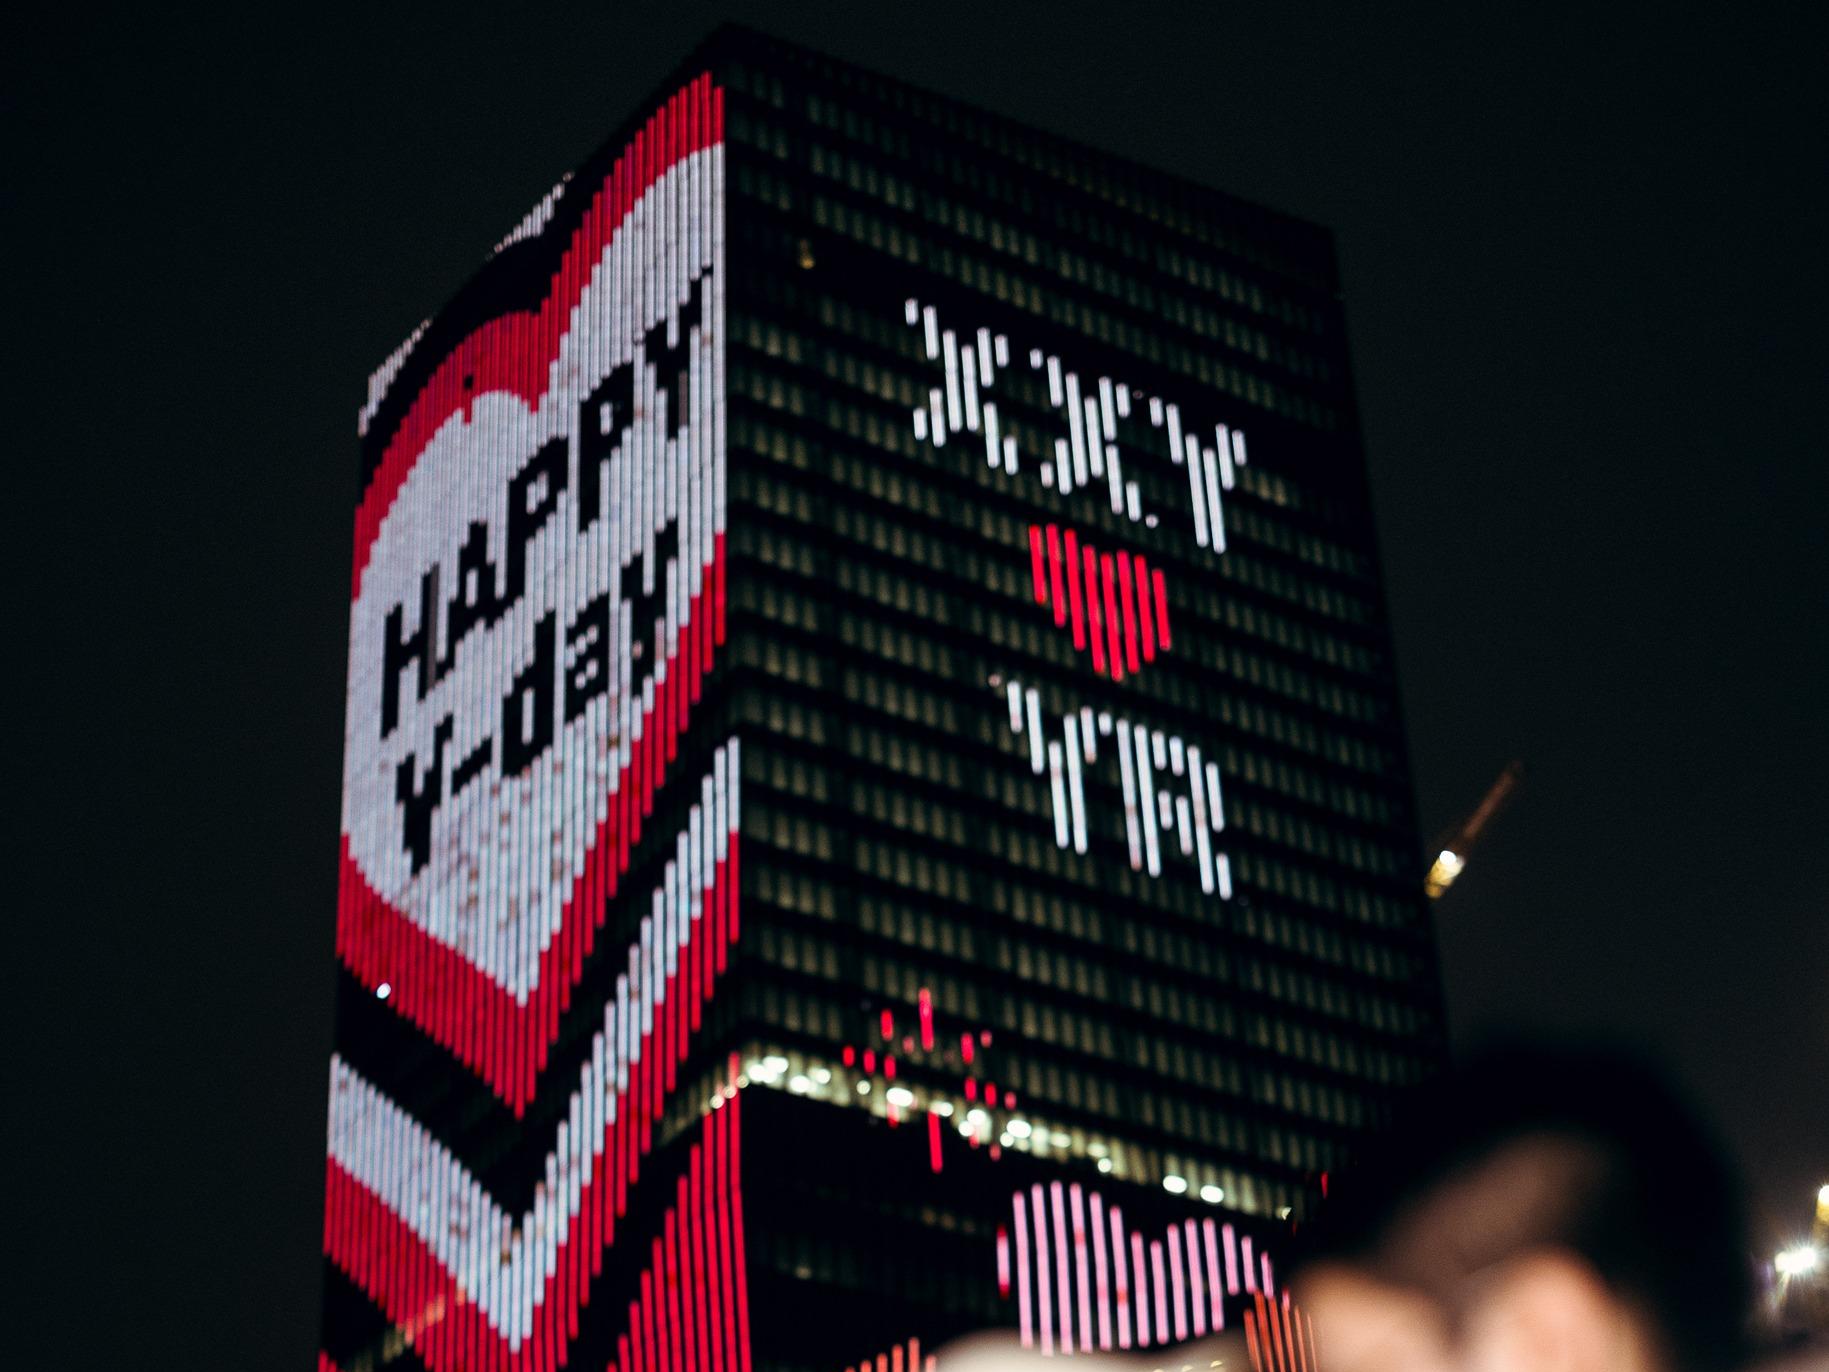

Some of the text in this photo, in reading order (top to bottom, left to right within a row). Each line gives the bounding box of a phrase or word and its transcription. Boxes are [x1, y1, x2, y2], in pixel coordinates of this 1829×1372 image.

[380, 265, 714, 740] HAPPY
[905, 298, 1247, 553] XXY
[990, 677, 1232, 900] YR
